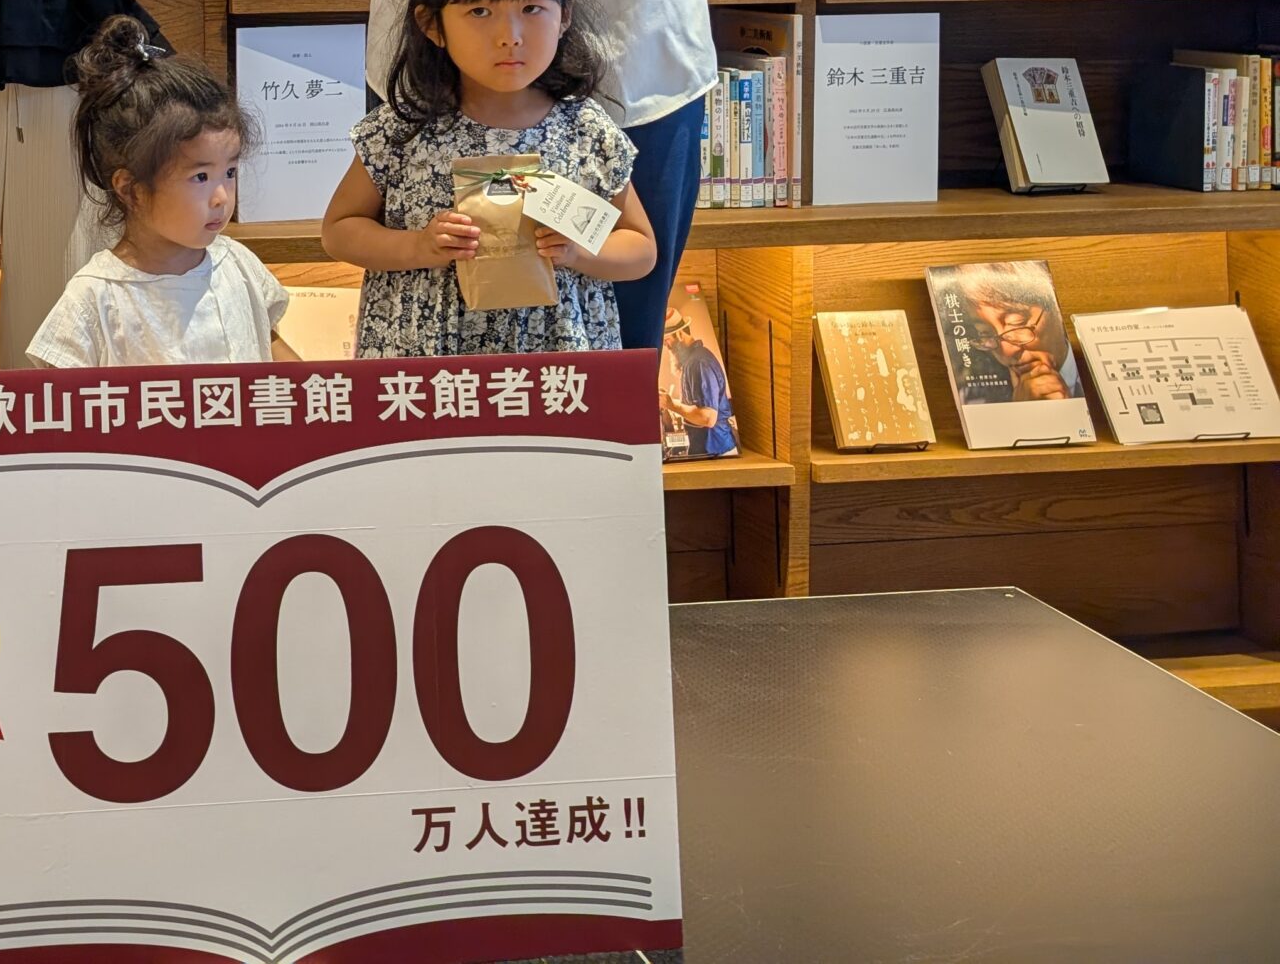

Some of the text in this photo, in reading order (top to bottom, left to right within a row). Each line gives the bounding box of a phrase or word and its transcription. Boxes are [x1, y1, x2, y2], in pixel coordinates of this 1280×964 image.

[261, 80, 343, 100] 竹久 夢二
[827, 66, 926, 86] 鈴木 三重吉
[944, 293, 972, 368] 棋士の瞬き
[378, 365, 590, 422] 来館者数
[48, 525, 576, 804] 500
[411, 796, 647, 853] 万人達成!!
